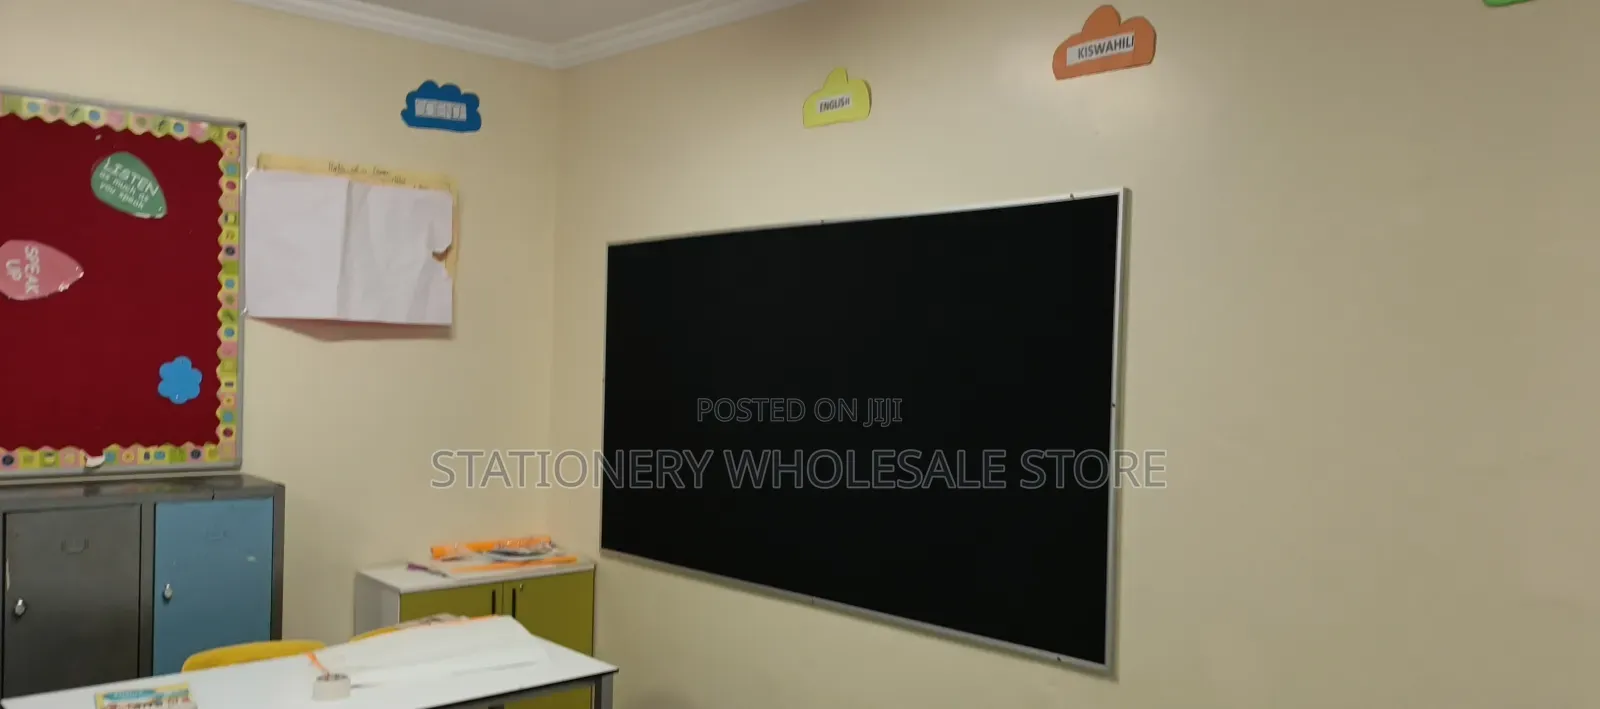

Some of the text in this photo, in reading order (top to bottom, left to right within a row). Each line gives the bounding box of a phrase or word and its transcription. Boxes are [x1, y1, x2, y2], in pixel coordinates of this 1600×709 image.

[1078, 37, 1134, 60] KISWAHILI
[820, 96, 850, 113] ENGLISH
[103, 156, 160, 197] LISTEN
[113, 178, 137, 196] much
[6, 258, 22, 281] UP
[24, 243, 40, 295] SPEAK
